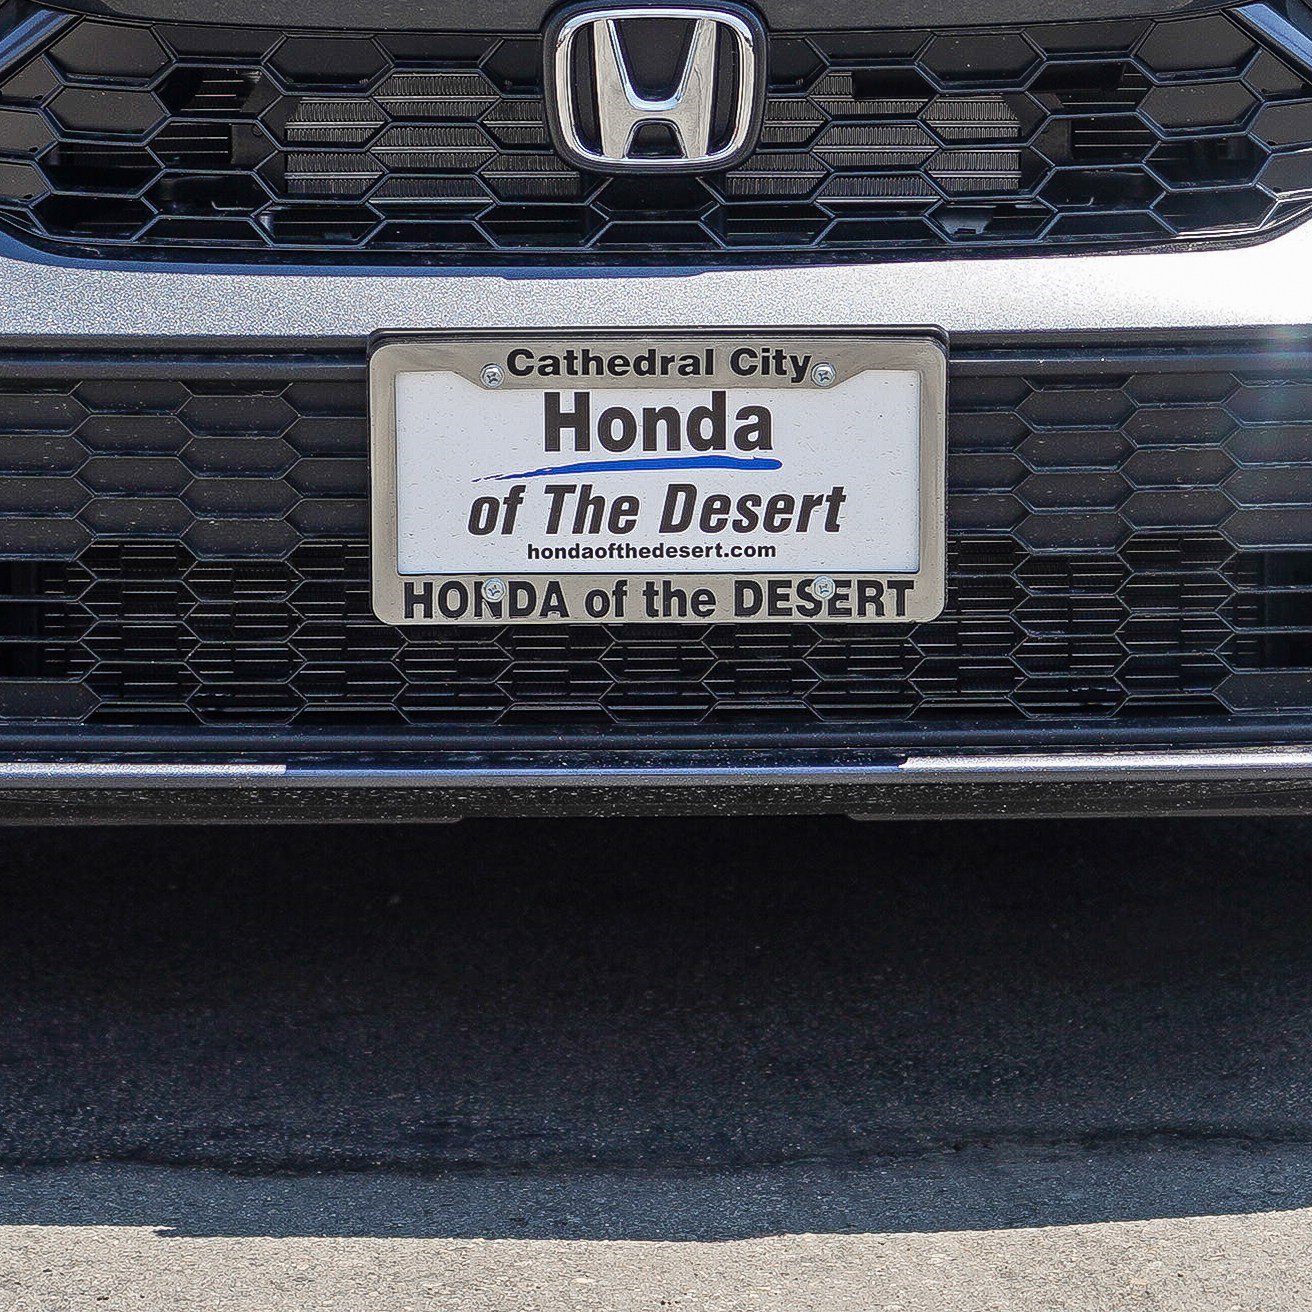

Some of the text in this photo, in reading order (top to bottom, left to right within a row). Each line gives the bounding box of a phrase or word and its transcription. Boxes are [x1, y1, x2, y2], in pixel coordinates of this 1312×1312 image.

[506, 347, 814, 384] Cathedral City
[543, 390, 774, 453] Honda
[467, 483, 847, 536] of The Desert
[527, 542, 777, 560] hondaofthedesert.com
[403, 578, 916, 620] HONDA of the DESERT
